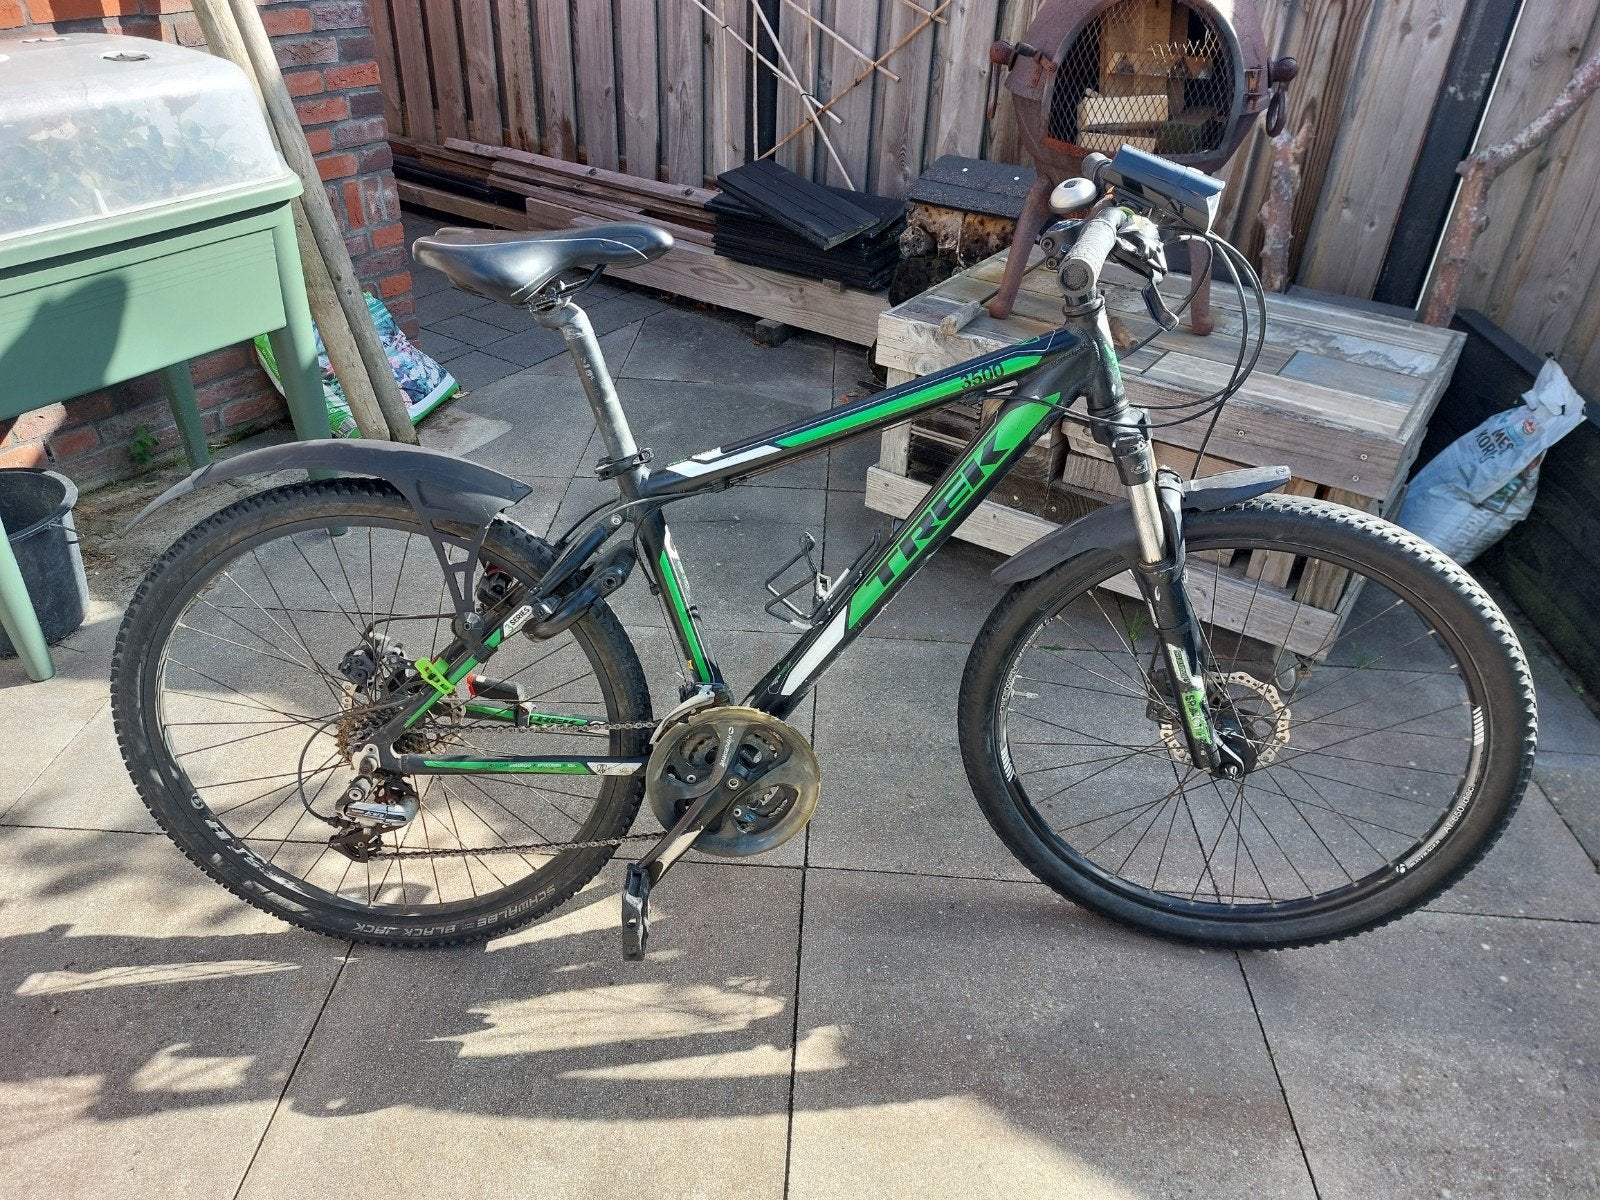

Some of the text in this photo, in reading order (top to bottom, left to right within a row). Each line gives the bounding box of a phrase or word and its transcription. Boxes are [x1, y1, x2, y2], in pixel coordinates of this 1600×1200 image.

[960, 362, 1005, 389] 3500
[865, 431, 1011, 588] TREK
[509, 606, 531, 627] SERIES
[1462, 786, 1475, 804] disc
[476, 884, 556, 928] SCHWALBE
[351, 921, 399, 936] JACK
[401, 922, 457, 937] BLACK
